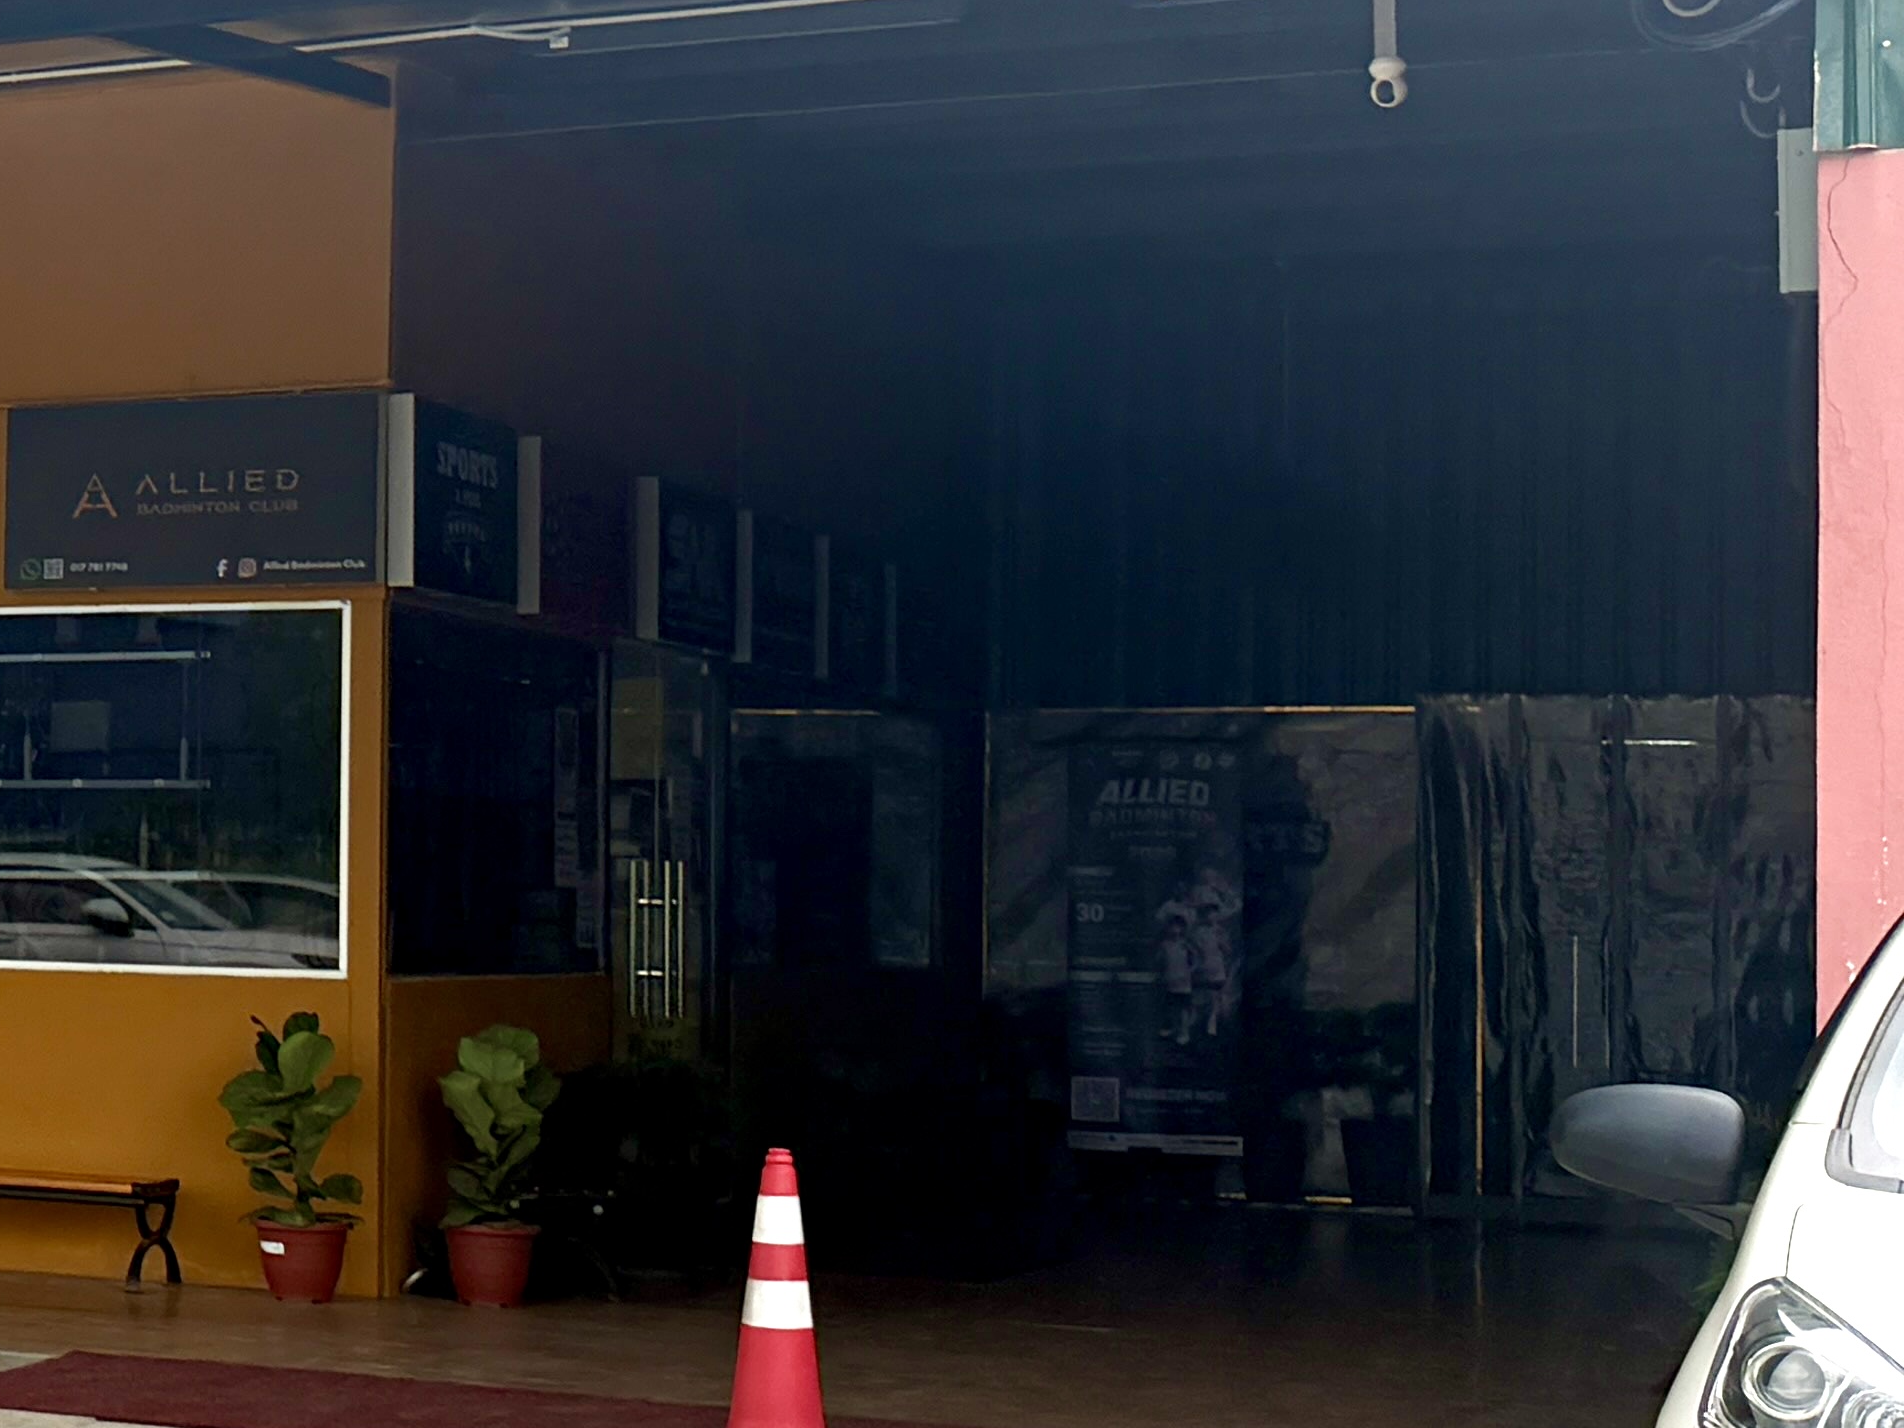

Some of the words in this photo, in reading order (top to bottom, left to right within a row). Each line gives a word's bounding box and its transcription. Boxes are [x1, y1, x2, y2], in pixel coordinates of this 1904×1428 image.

[136, 500, 240, 517] BADMINTON
[248, 498, 299, 514] CLUB
[1097, 777, 1210, 806] ALLIED
[1076, 902, 1105, 923] 30
